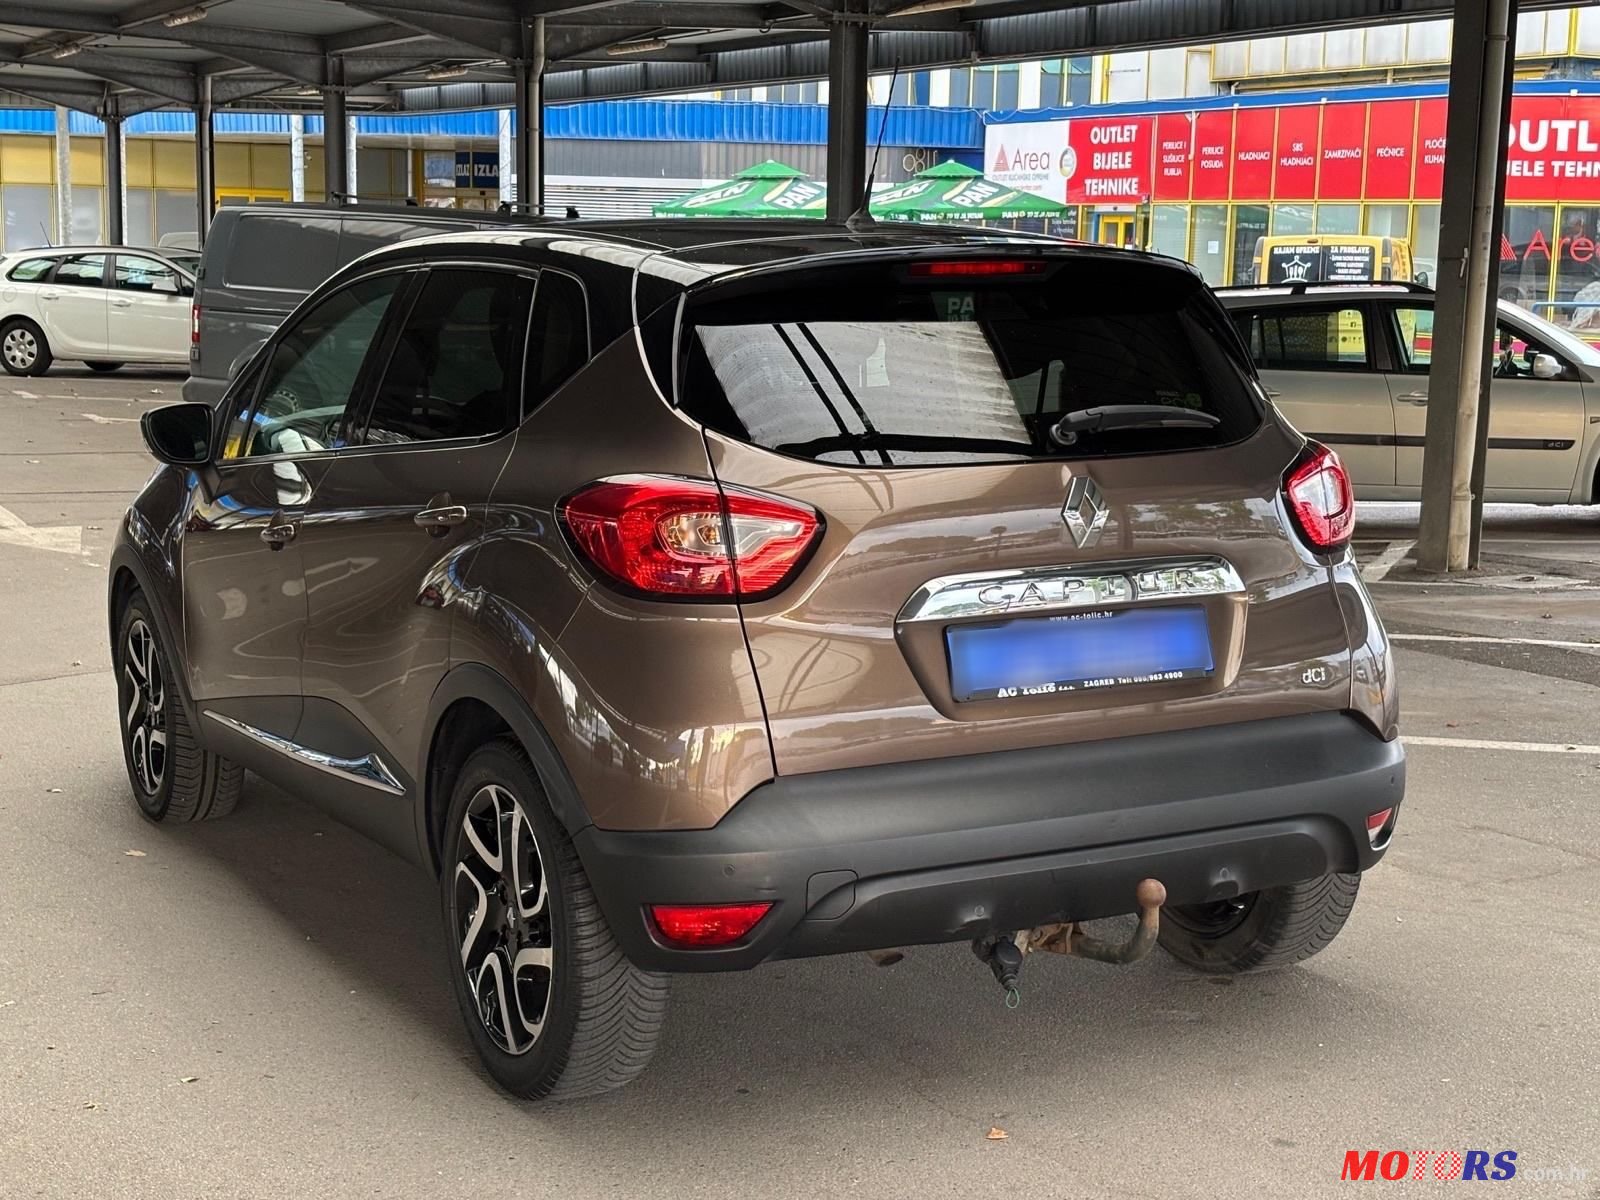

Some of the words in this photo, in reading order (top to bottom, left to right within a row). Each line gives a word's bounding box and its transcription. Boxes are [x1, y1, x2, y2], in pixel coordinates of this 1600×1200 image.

[1090, 124, 1138, 144] OUTLET
[1239, 151, 1271, 161] HLADNJACI
[1292, 142, 1303, 152] SBS
[1012, 147, 1050, 171] Area
[1093, 151, 1133, 170] BIJELE
[1280, 157, 1313, 166] HLADNJACI
[1424, 154, 1446, 164] KUHA
[473, 164, 499, 176] IZLA
[773, 183, 821, 209] PAN
[951, 181, 999, 208] PAN
[1084, 177, 1139, 196] TEHNIKE
[1523, 229, 1600, 262] Are
[978, 568, 1198, 606] CAPTUR
[997, 687, 1018, 698] AC
[1083, 678, 1115, 687] ZAGREB
